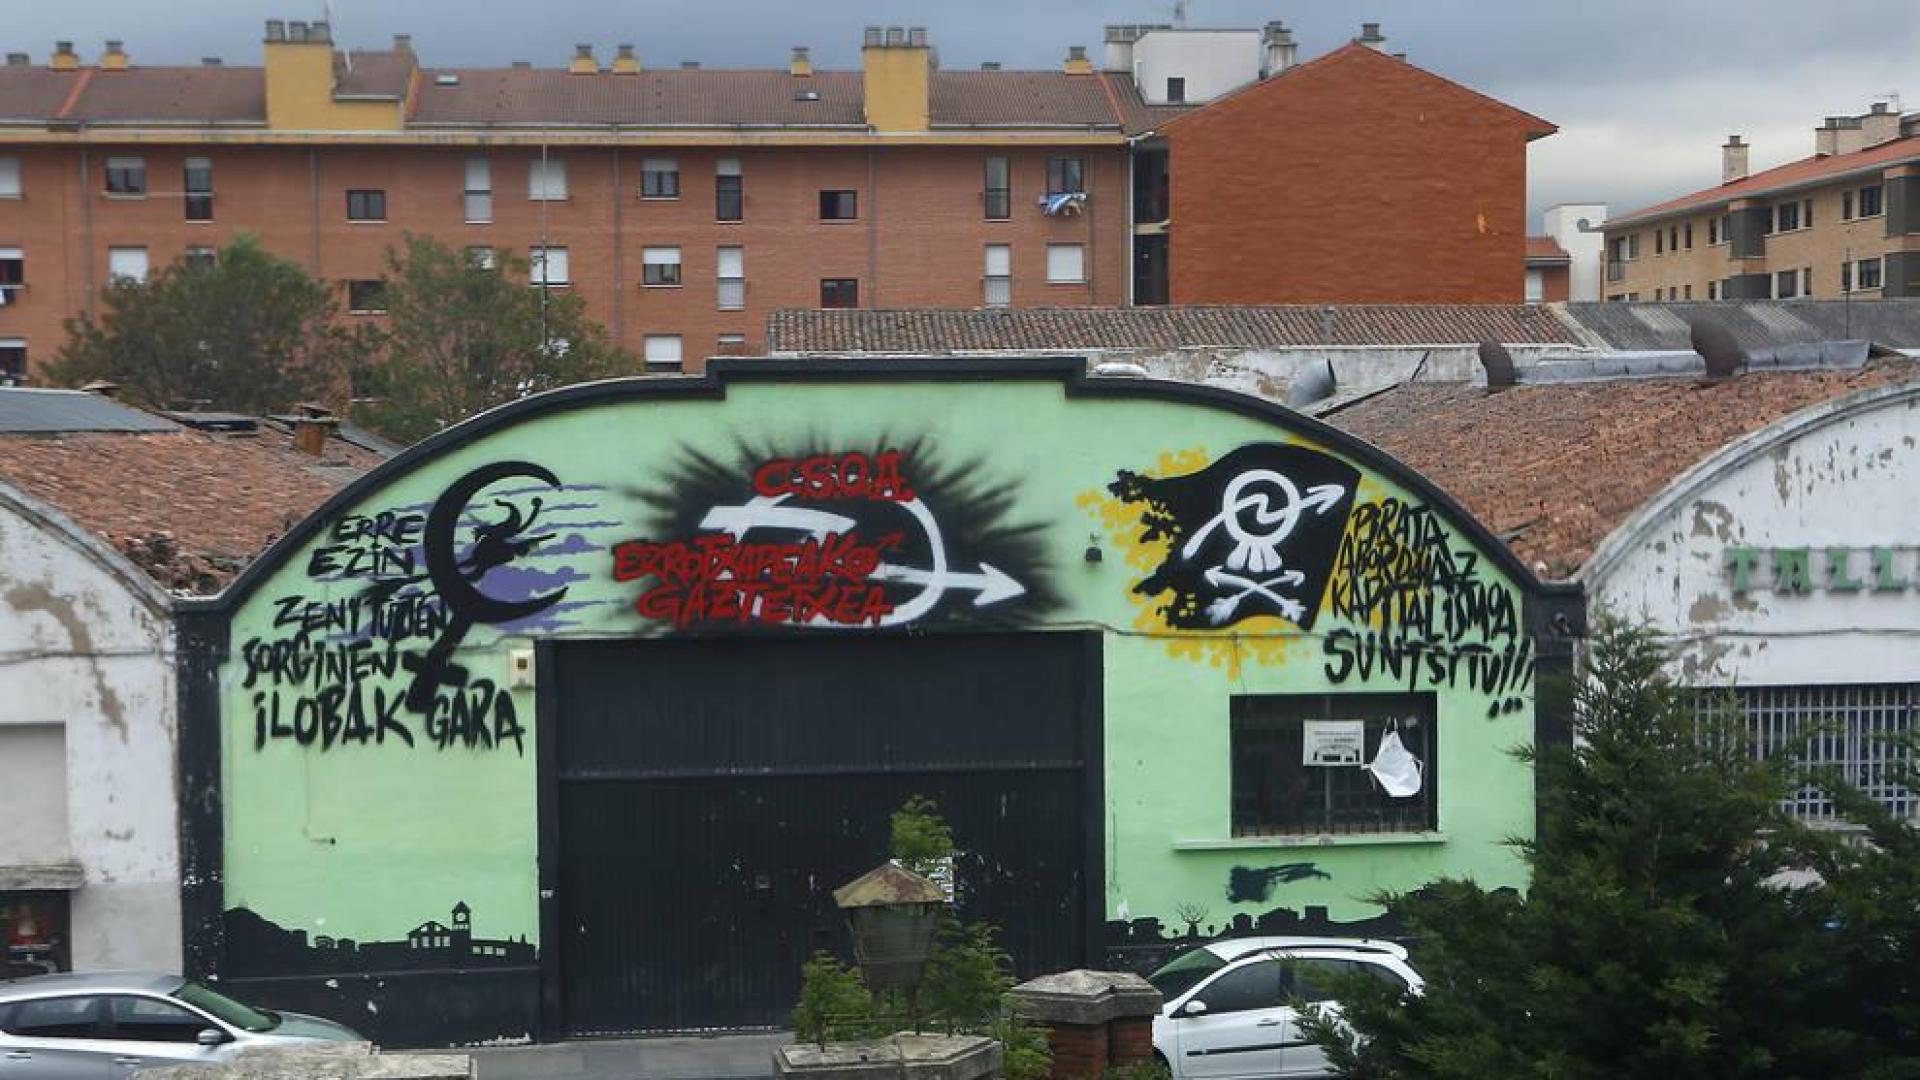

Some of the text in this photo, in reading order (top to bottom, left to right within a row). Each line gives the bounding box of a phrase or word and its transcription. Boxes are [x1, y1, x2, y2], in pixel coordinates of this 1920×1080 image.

[334, 511, 425, 545] ERRE
[1351, 498, 1450, 546] PIRATA
[1725, 547, 1920, 592] TALL
[636, 582, 895, 627] GAZTETXEA
[241, 630, 399, 689] SORGINEN
[425, 677, 525, 757] GARA
